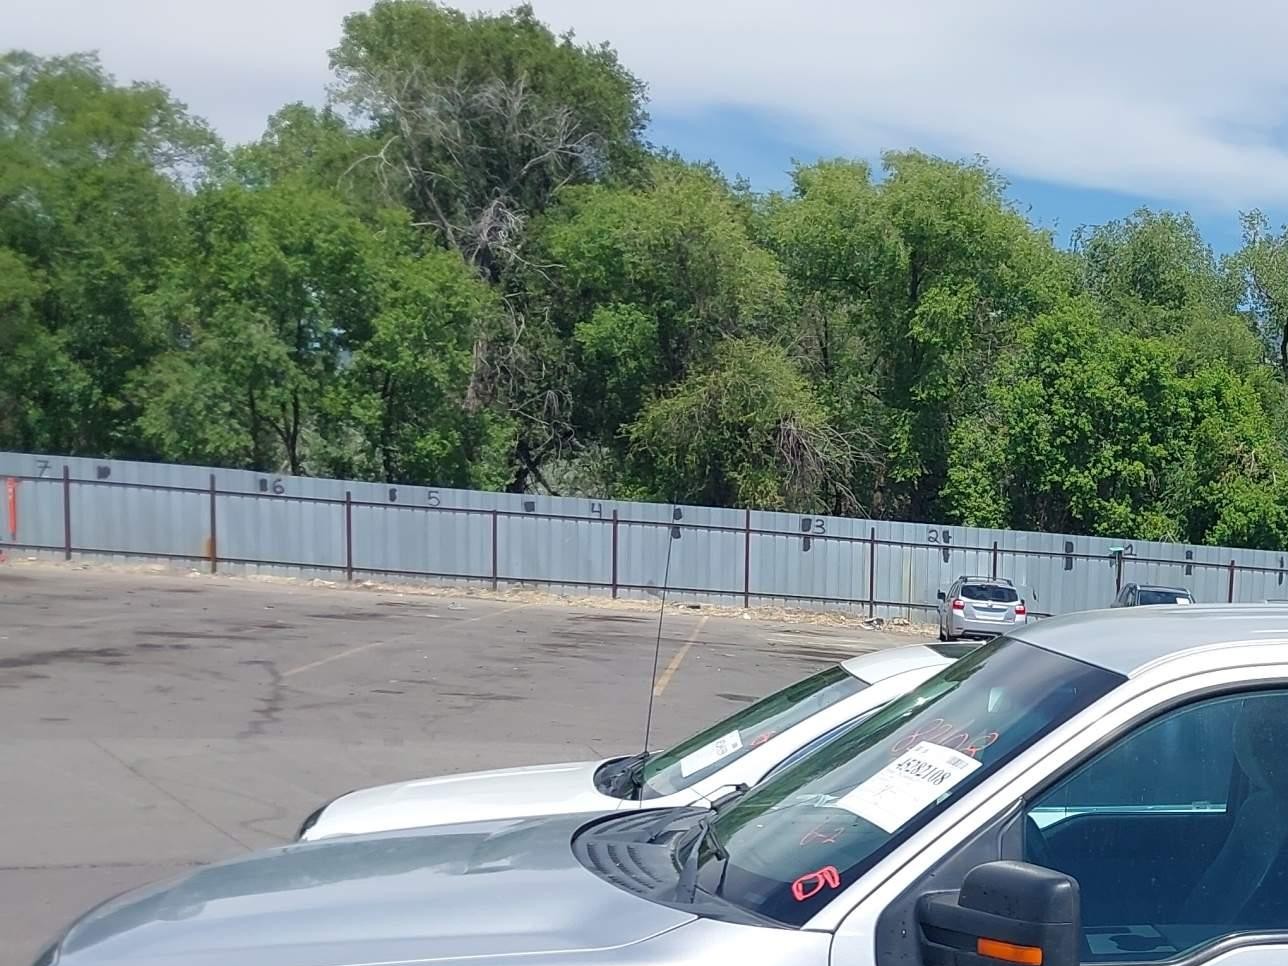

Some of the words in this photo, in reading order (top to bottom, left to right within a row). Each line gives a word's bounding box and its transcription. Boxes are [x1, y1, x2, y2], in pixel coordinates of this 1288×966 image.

[36, 459, 51, 477] 7
[272, 479, 286, 495] 6
[427, 490, 442, 507] 5
[590, 502, 603, 515] 4
[812, 518, 827, 535] 3
[927, 528, 940, 544] 2
